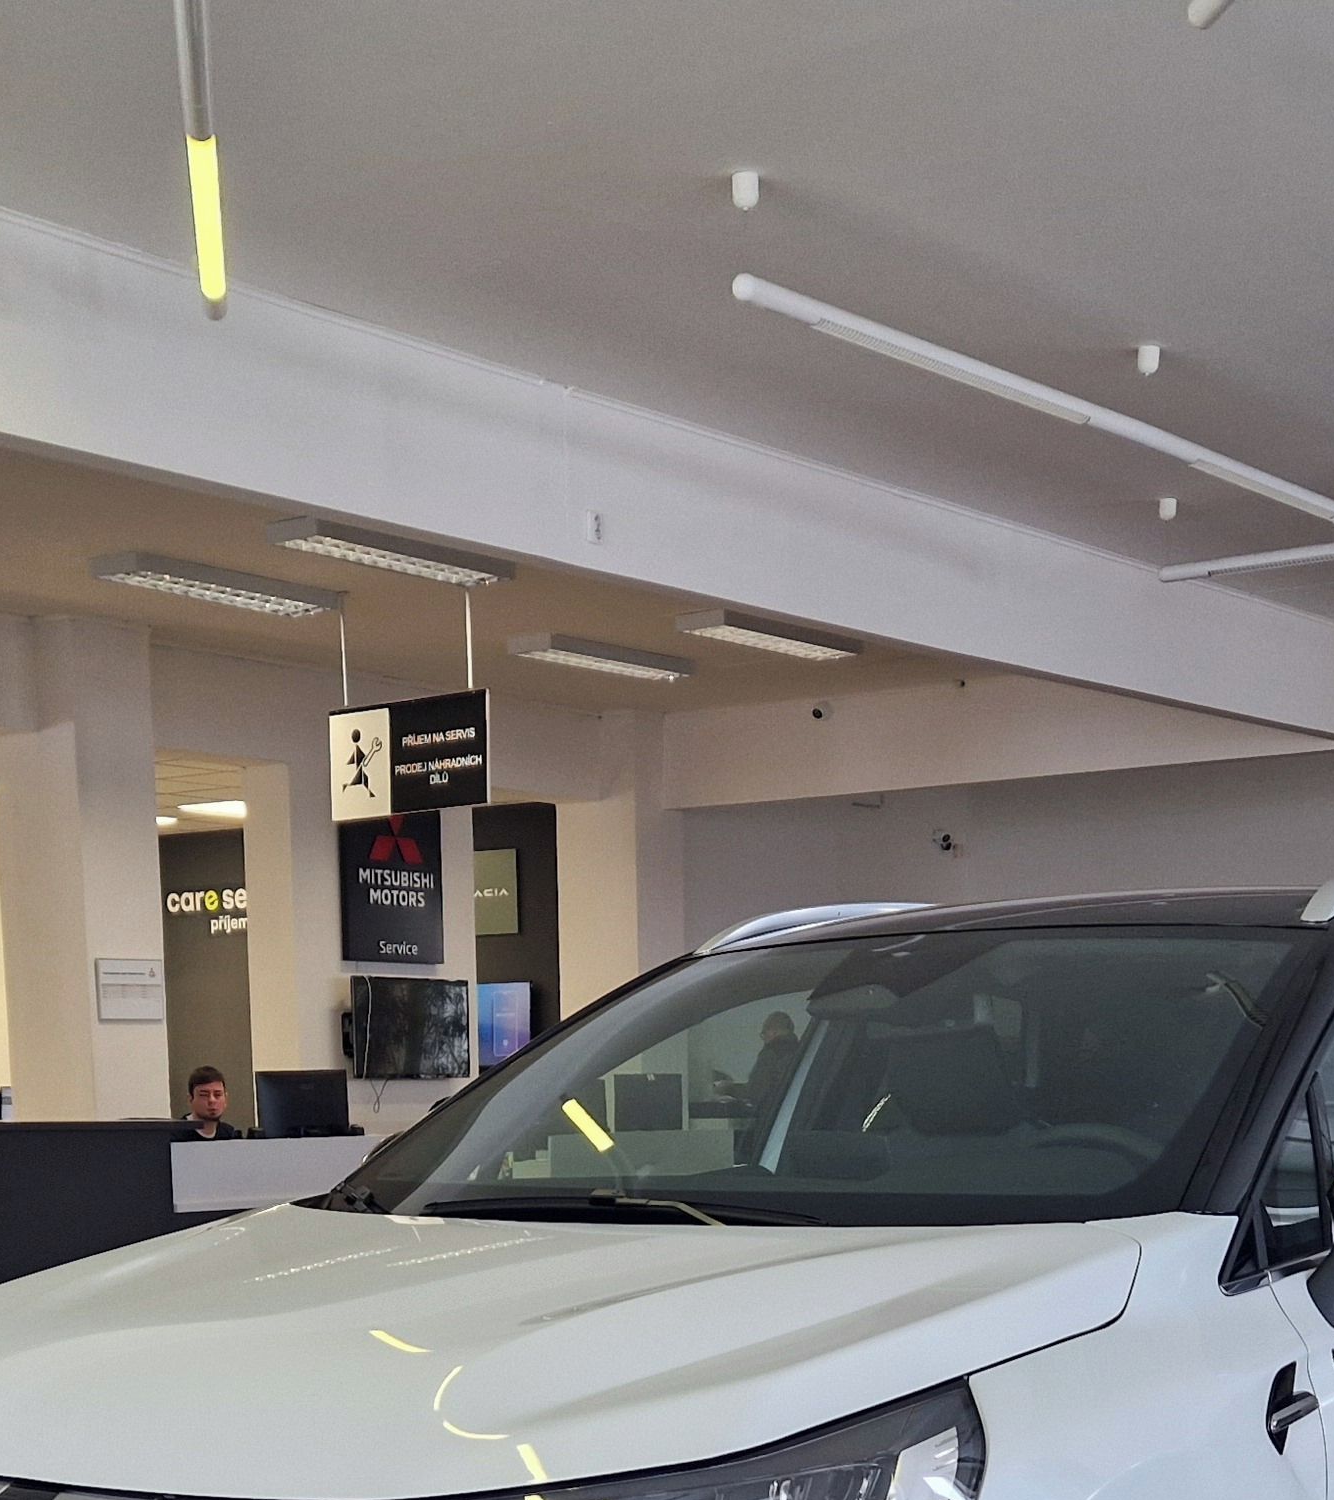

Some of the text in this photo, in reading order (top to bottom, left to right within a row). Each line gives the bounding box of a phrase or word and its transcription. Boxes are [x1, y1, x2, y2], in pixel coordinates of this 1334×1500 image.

[402, 727, 476, 748] PŘÍJEM NA SERVIS
[394, 754, 483, 776] PRODEJ NÁHRADNÍCH
[429, 771, 449, 785] DÍLŮ
[358, 867, 434, 889] MITSUBISHI
[166, 889, 219, 913] care
[369, 888, 426, 908] MOTORS
[379, 940, 419, 955] Service
